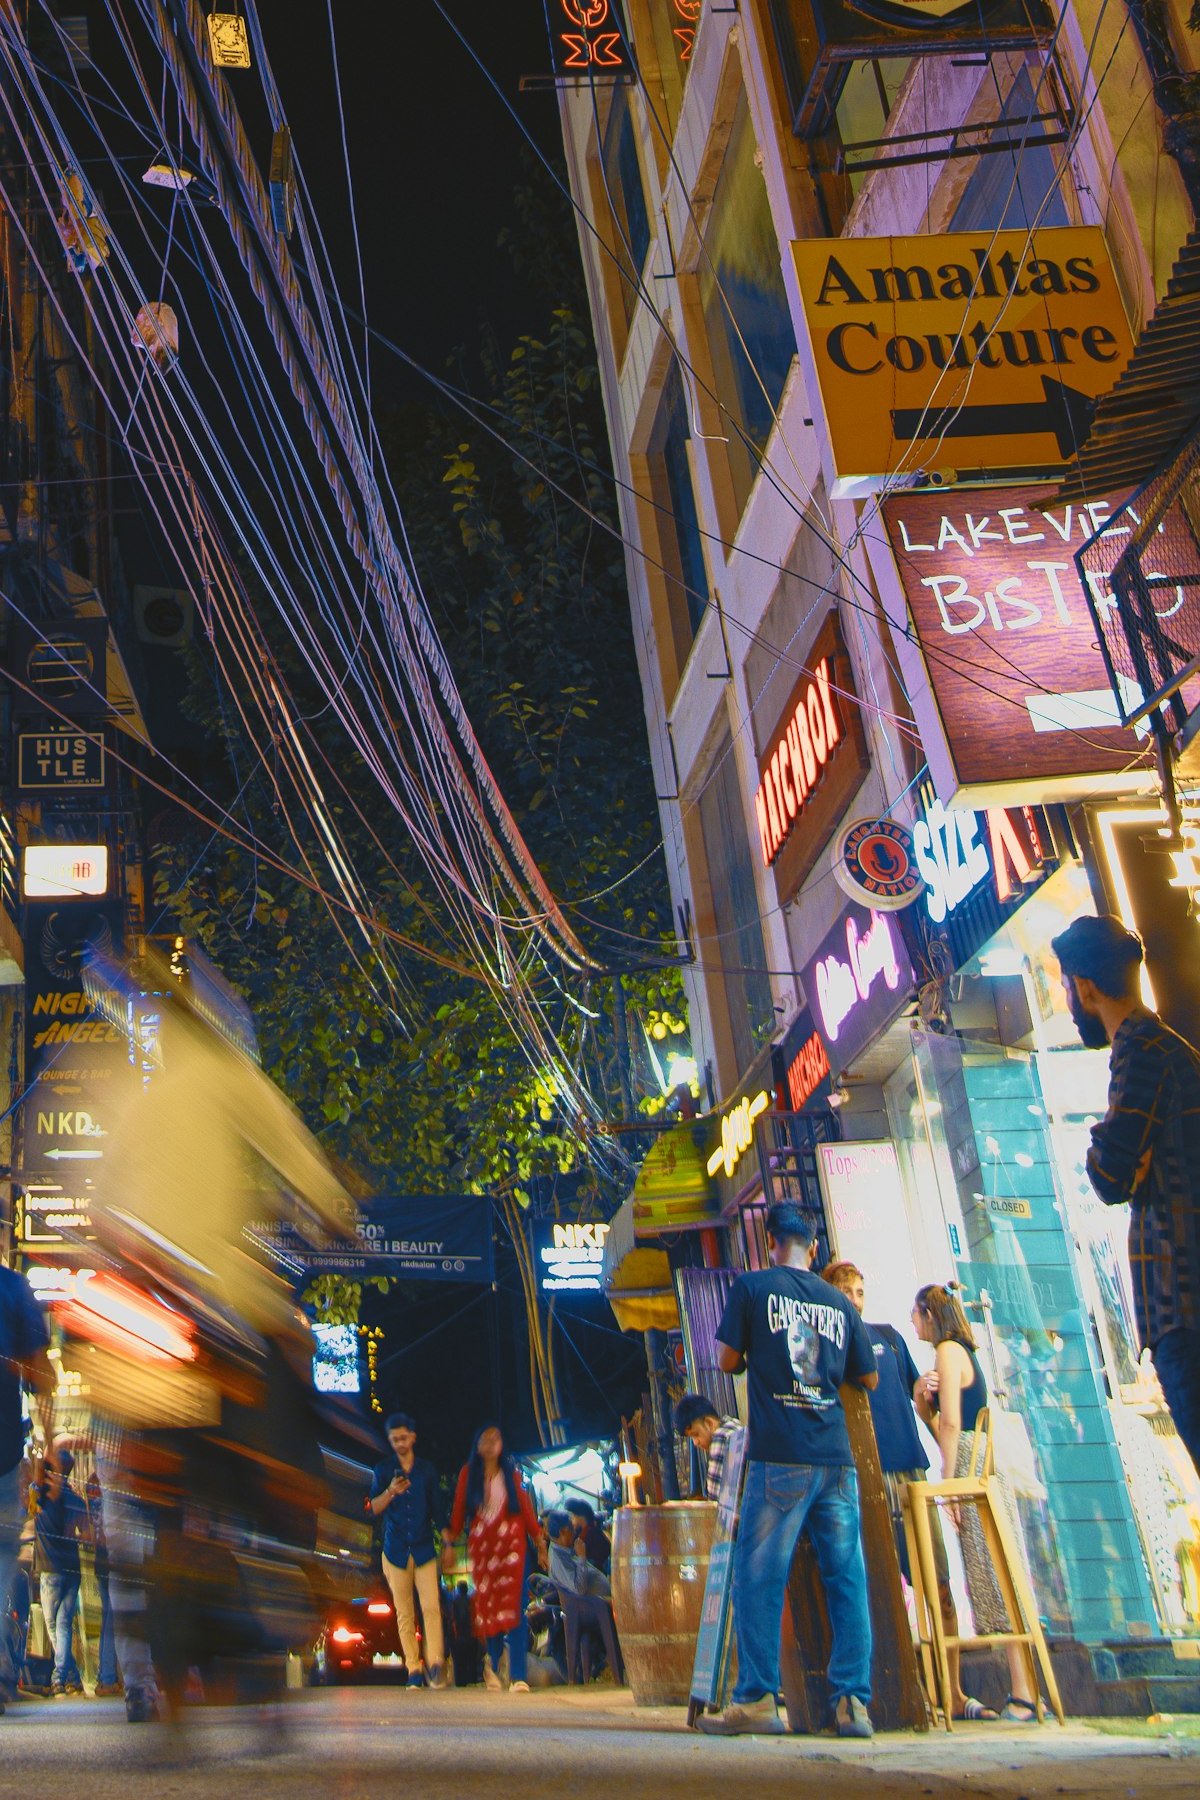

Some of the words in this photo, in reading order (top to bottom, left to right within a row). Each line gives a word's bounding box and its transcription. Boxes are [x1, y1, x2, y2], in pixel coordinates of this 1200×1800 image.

[814, 248, 1101, 306] Amaltas
[826, 319, 1120, 376] Couture
[754, 656, 840, 868] MATCHBOX
[846, 823, 912, 860] LAUGHTER
[38, 1069, 79, 1082] LOUNGE
[990, 1199, 1025, 1214] CLOSED
[391, 1240, 444, 1254] BEAUTY
[400, 1259, 436, 1270] nkdsalon
